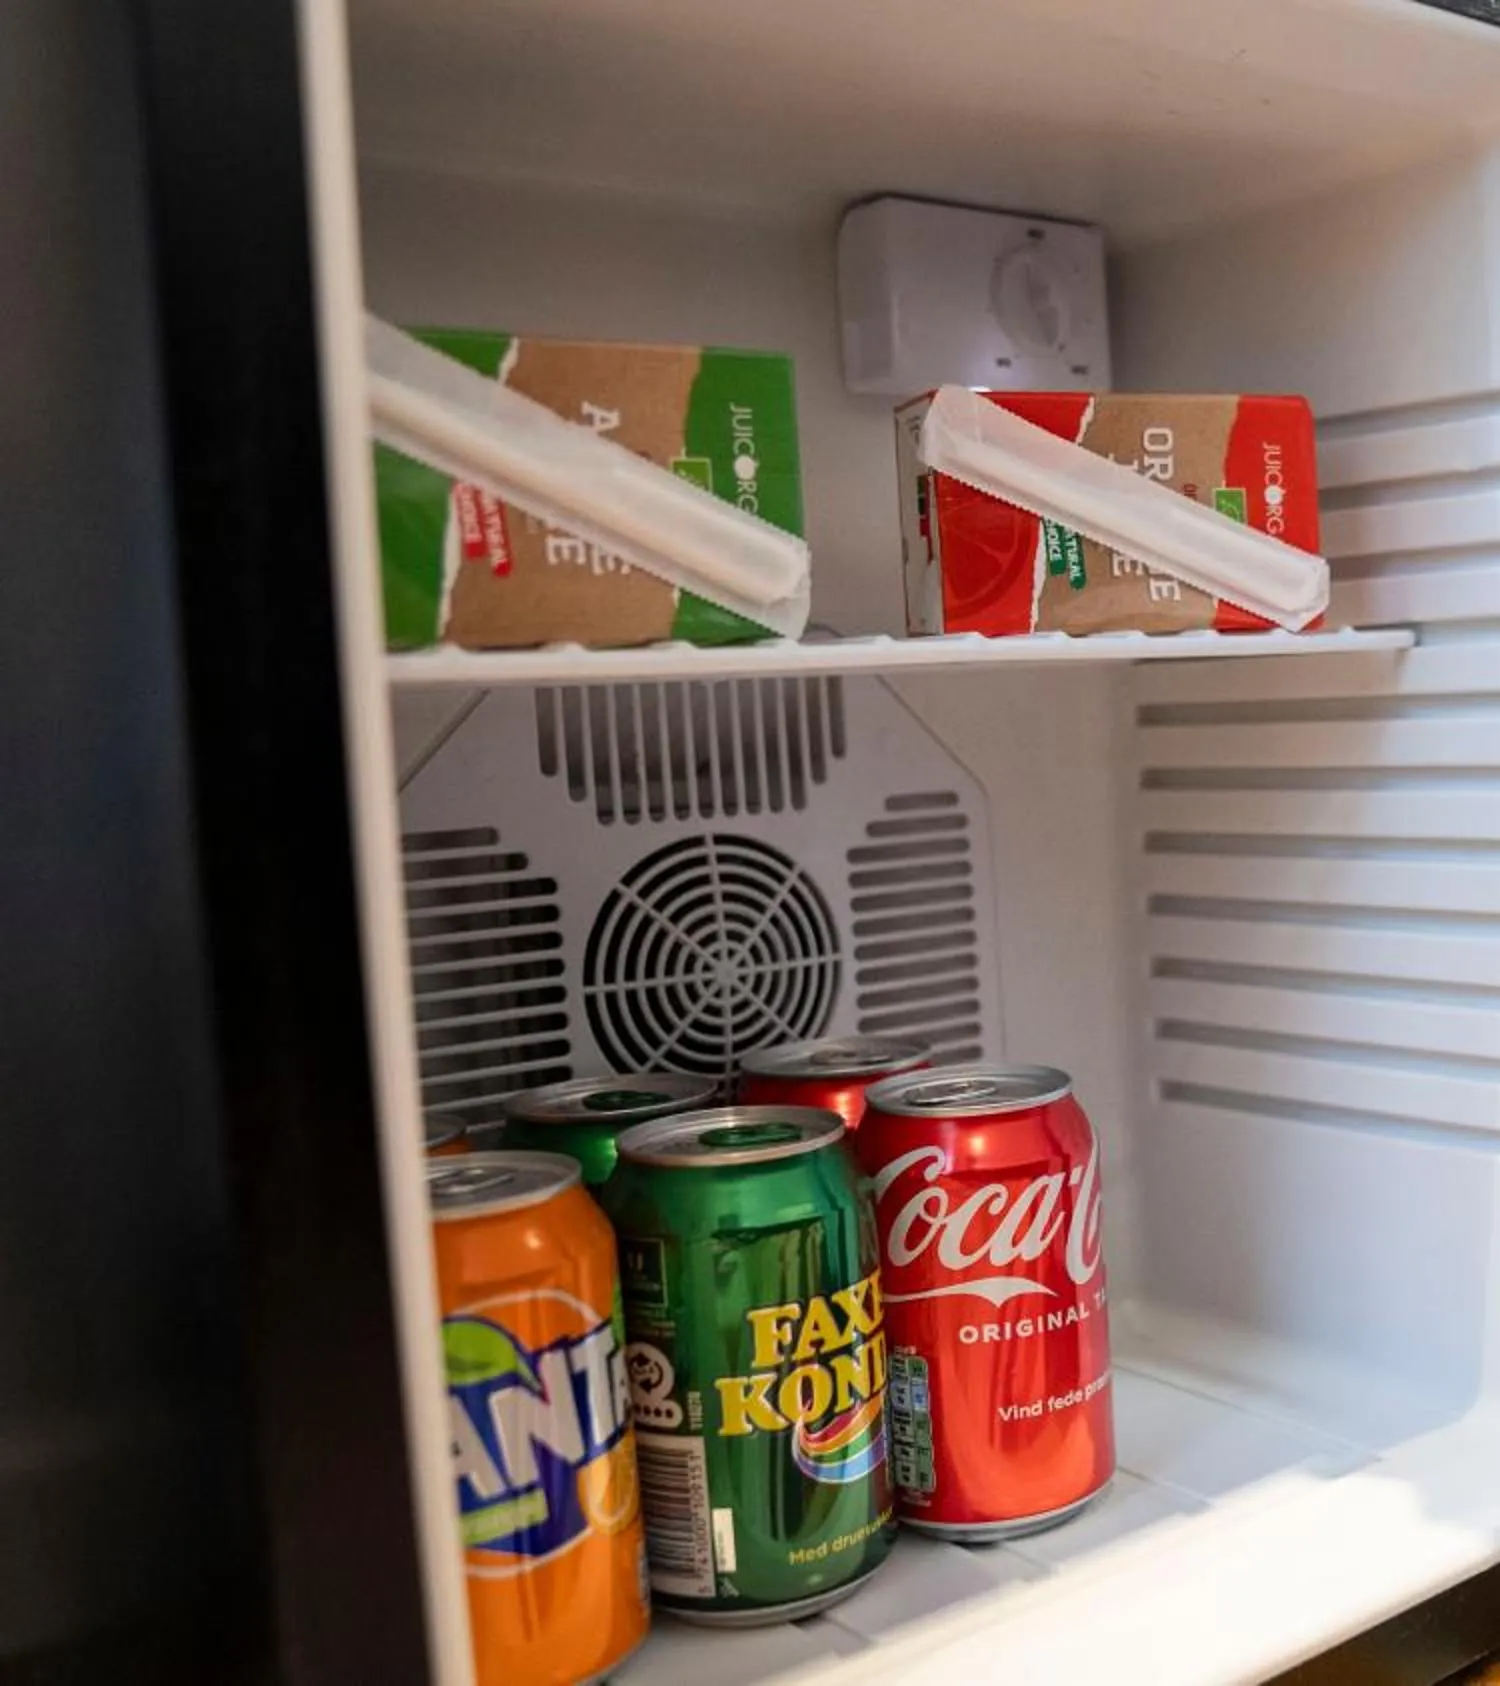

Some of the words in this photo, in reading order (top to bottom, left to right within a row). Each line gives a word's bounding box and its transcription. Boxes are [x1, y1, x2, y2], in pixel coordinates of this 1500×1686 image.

[959, 1307, 1090, 1344] ORIGINAL
[998, 1400, 1043, 1422] Vind
[1048, 1389, 1083, 1413] fede
